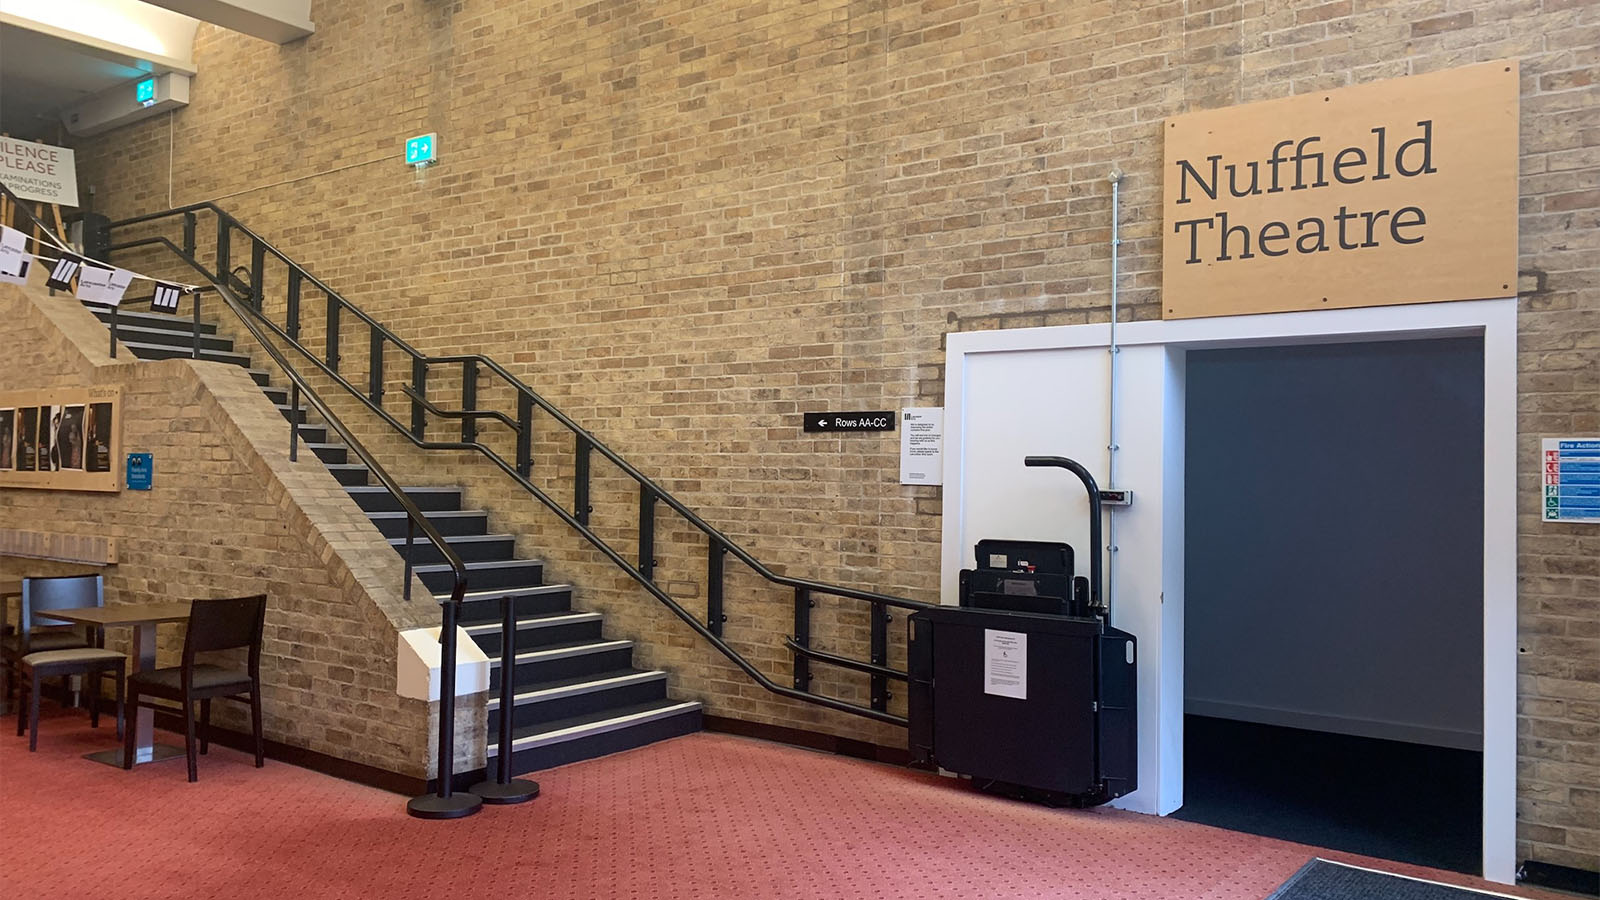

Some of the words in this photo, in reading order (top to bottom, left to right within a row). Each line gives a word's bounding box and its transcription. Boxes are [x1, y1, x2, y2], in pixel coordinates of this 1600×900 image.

[0, 141, 59, 163] ILENCE
[1175, 119, 1437, 205] Nuffield
[8, 182, 58, 198] PROGRESS
[1174, 203, 1427, 265] Theatre
[835, 417, 857, 428] Rows
[859, 417, 887, 428] AA-CC
